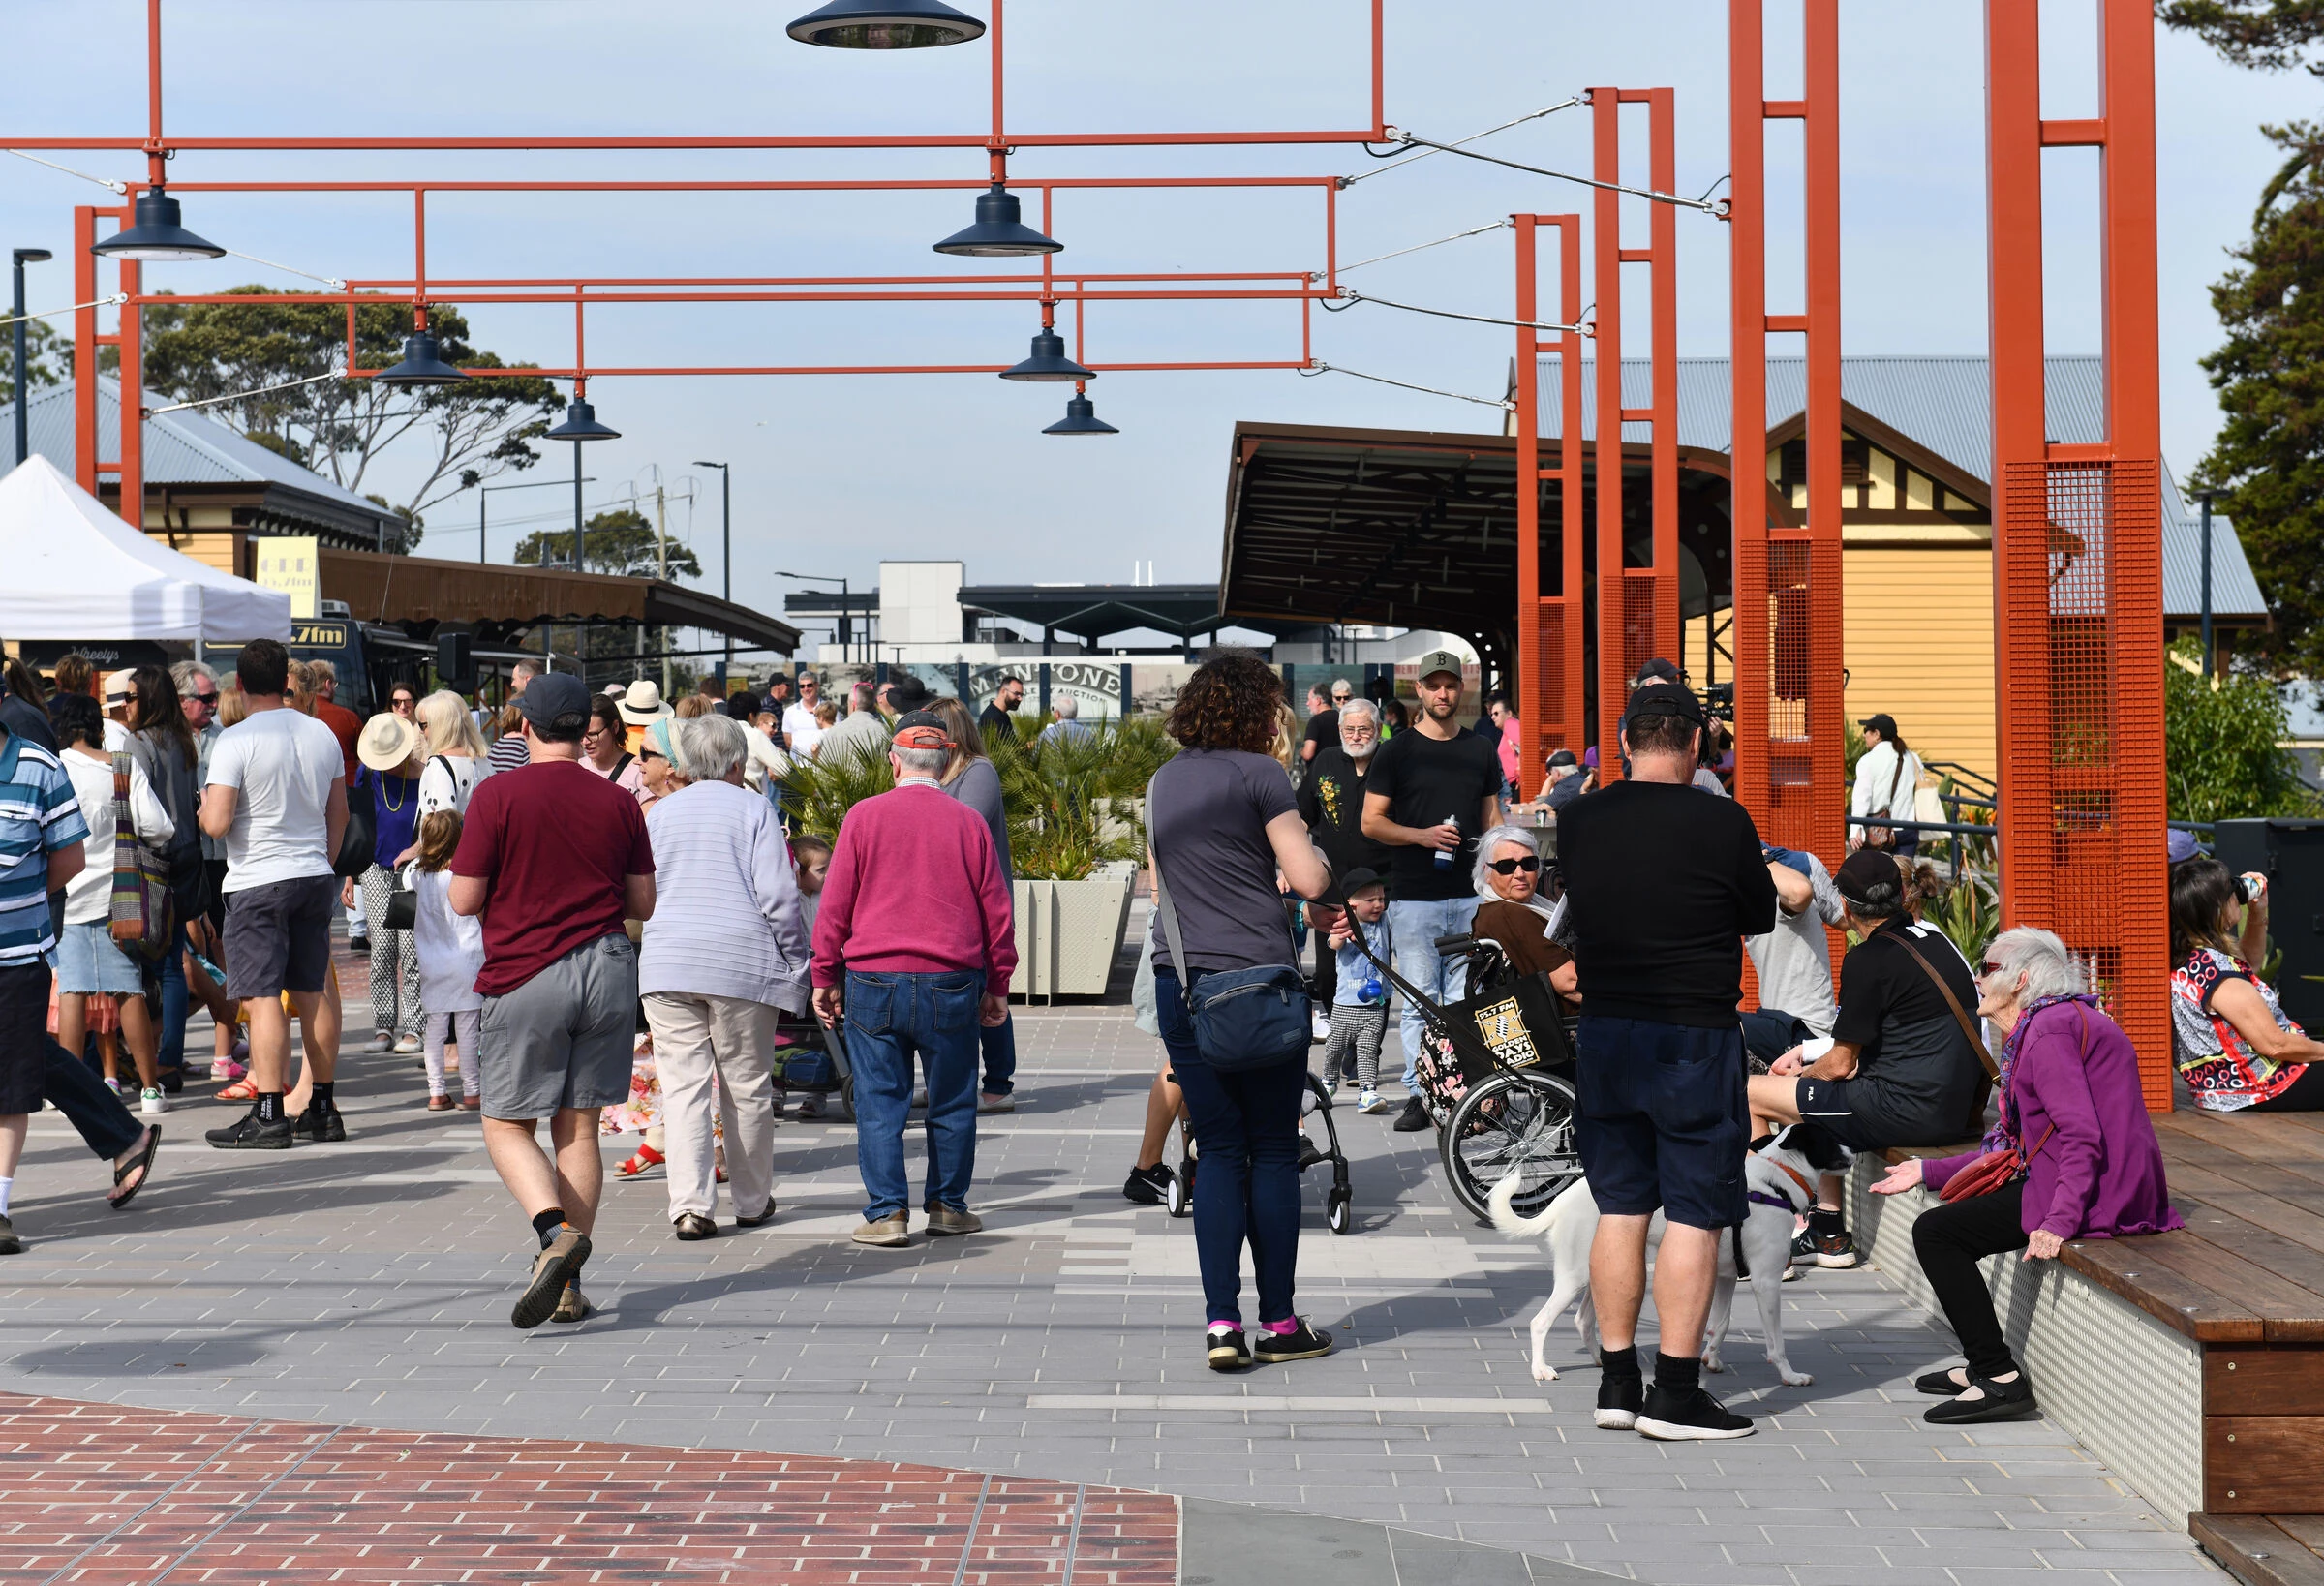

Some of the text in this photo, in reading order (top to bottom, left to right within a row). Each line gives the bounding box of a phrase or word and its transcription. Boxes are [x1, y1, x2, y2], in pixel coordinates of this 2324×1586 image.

[291, 626, 342, 644] .7fm
[1436, 654, 1446, 666] B
[969, 663, 1120, 698] MENONE
[1479, 1001, 1514, 1020] 95.7 FM
[1492, 1035, 1527, 1052] GOLDEN
[1495, 1042, 1531, 1060] DAYS
[1504, 1051, 1535, 1066] ADIO
